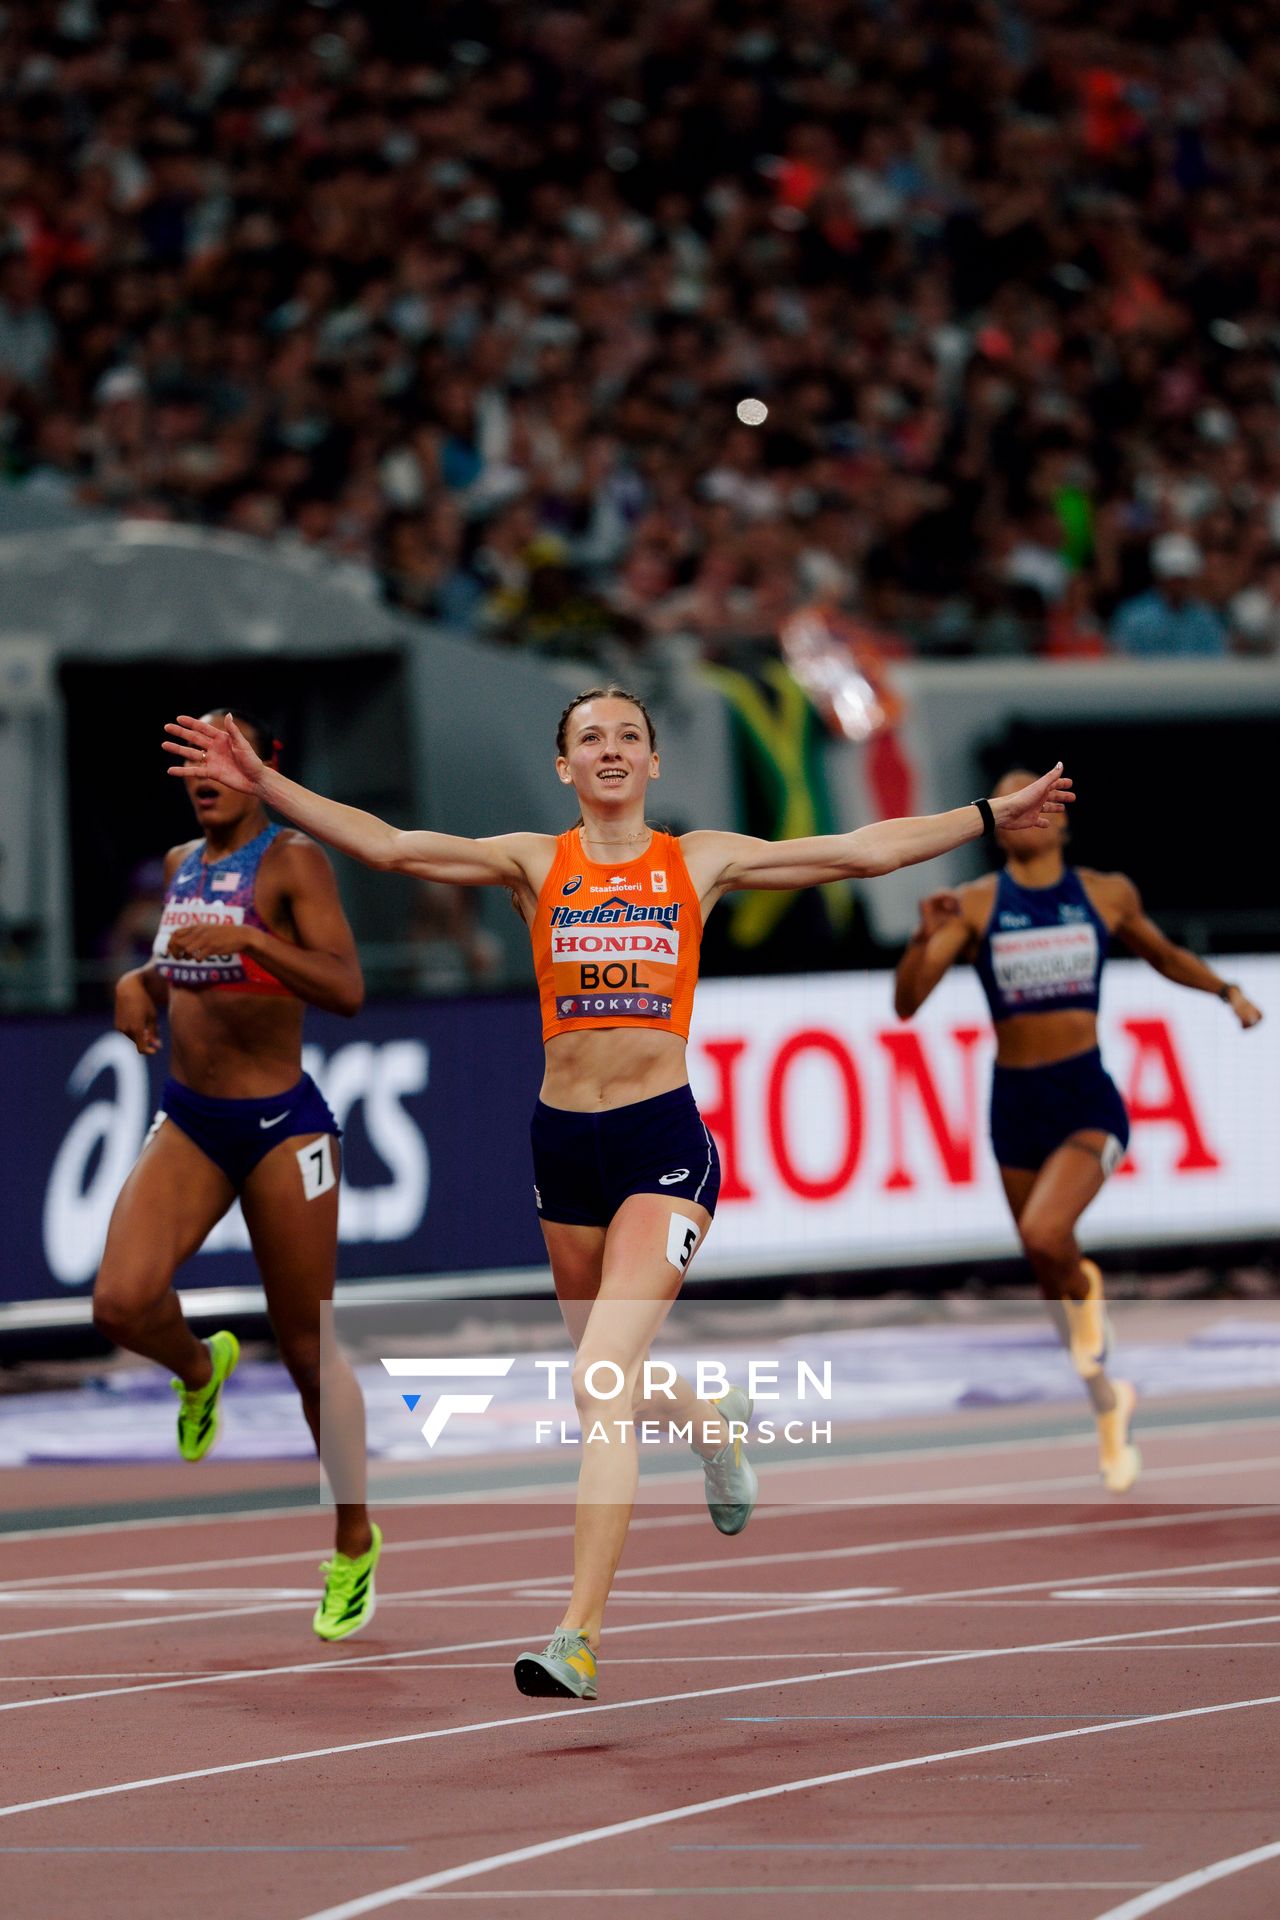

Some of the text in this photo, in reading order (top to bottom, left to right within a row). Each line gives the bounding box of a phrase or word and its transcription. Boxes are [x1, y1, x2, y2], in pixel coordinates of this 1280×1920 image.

[590, 883, 642, 893] Staatsloterij
[554, 936, 675, 955] HONDA
[580, 963, 649, 989] BOL
[310, 1149, 324, 1187] 7
[680, 1228, 697, 1268] 5
